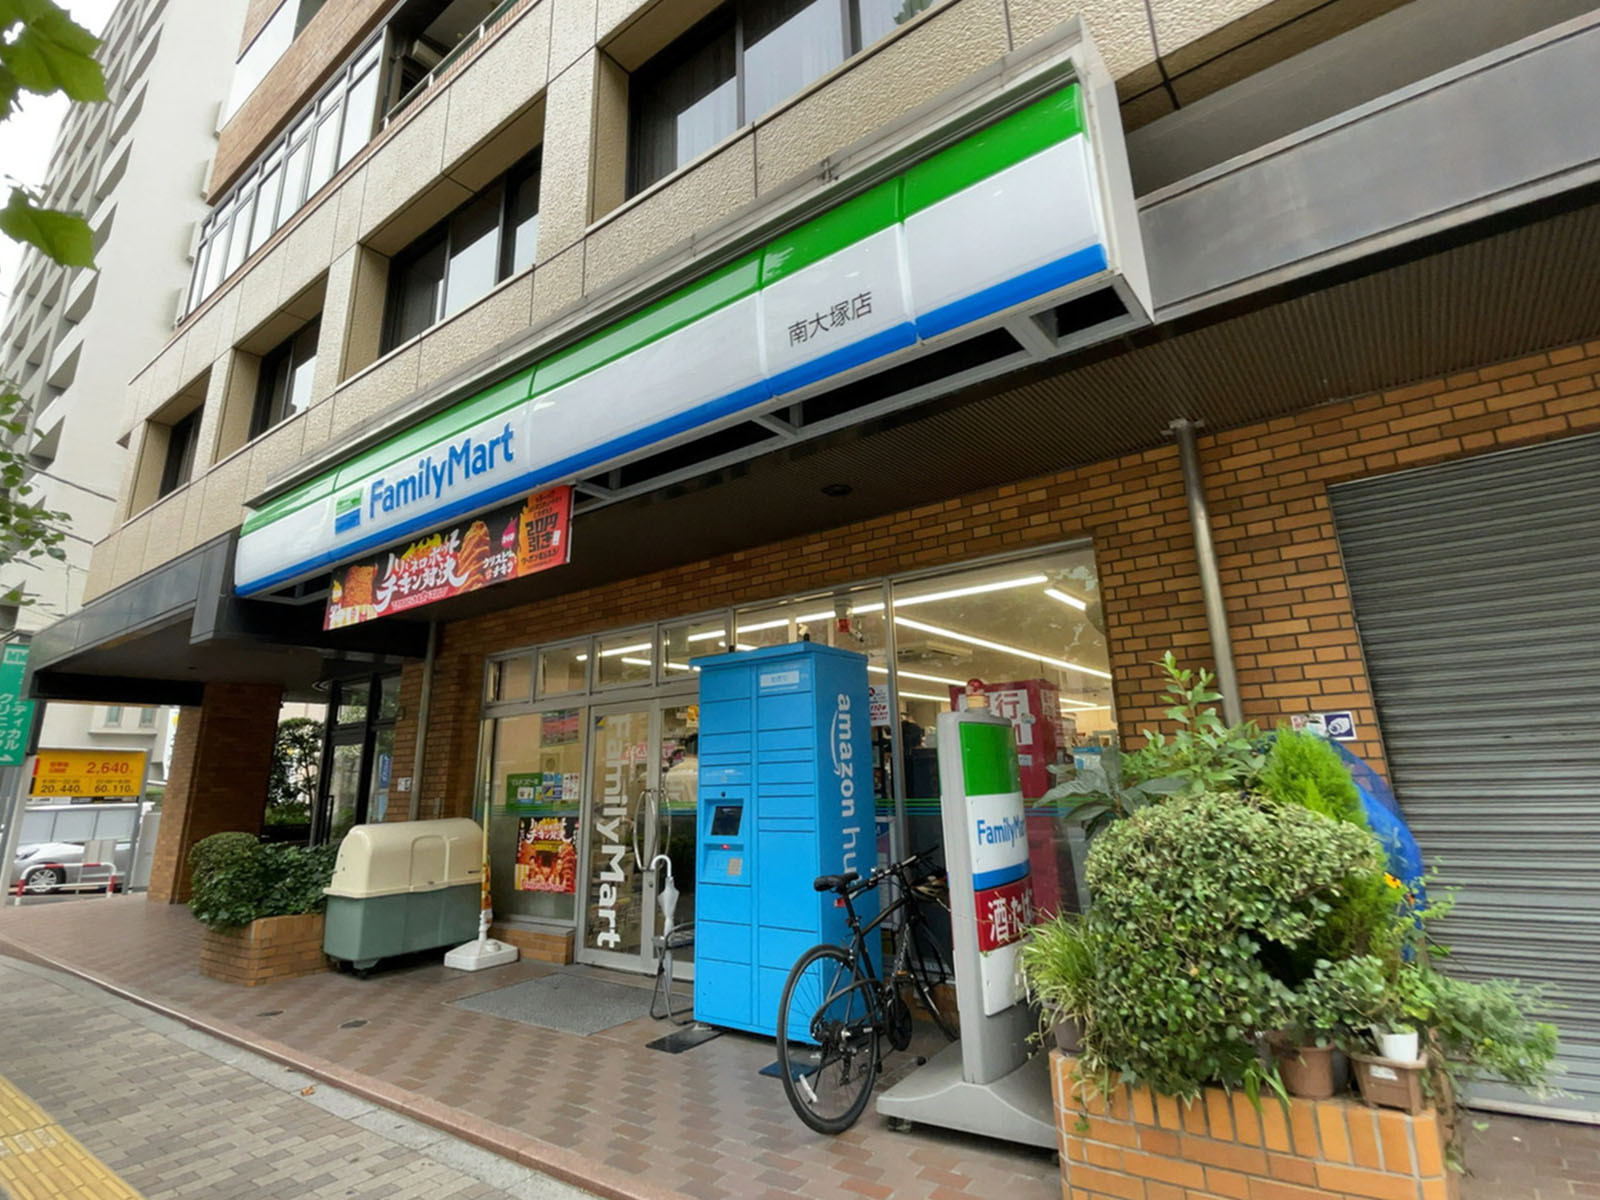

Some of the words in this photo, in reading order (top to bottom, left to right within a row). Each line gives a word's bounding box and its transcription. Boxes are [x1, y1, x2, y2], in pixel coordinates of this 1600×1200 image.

[787, 291, 872, 347] 南大塚店
[370, 422, 514, 519] FamilyMart
[837, 693, 856, 818] amazon
[596, 715, 632, 948] FamilyMart
[842, 827, 862, 882] hu
